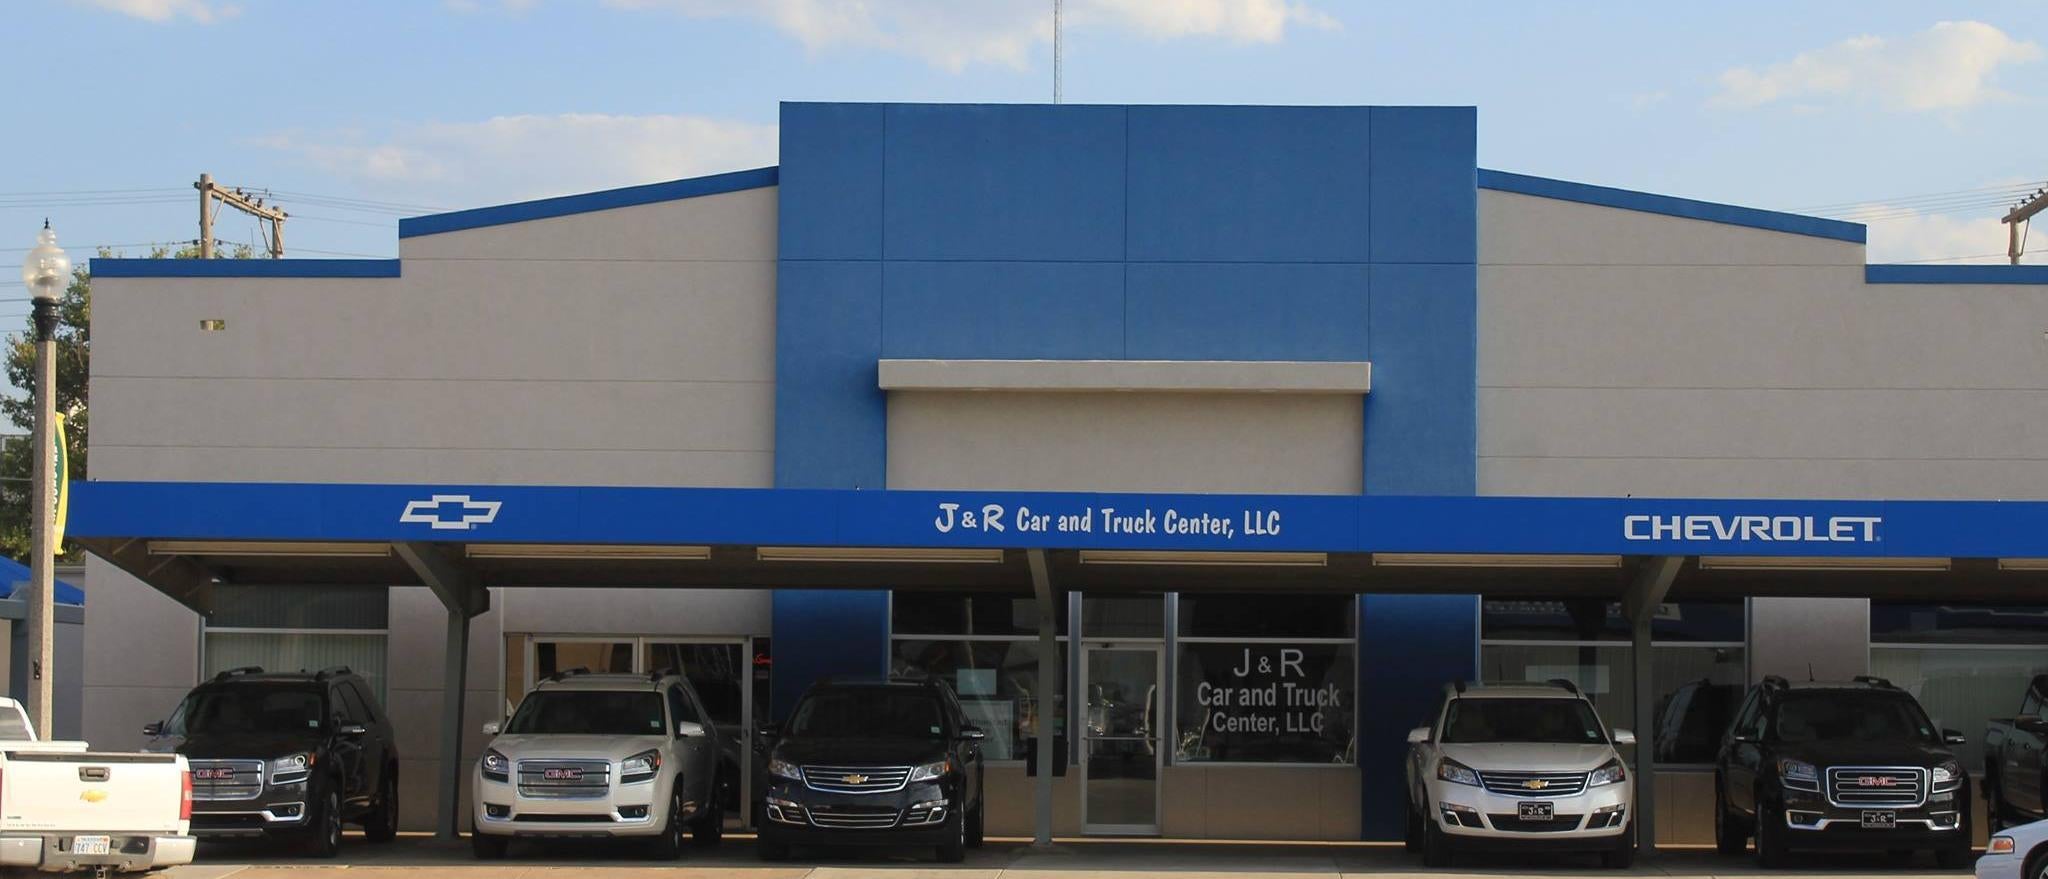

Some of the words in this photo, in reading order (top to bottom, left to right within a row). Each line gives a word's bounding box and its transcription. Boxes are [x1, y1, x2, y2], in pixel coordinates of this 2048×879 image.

[1016, 506, 1051, 532] Car
[1058, 507, 1092, 533] and
[1101, 507, 1156, 534] Truck
[1163, 508, 1234, 539] Center,
[1244, 510, 1281, 536] LLC
[1623, 515, 1882, 542] CHEVROLET
[1233, 648, 1250, 677] J
[1257, 656, 1272, 674] &
[1280, 648, 1305, 677] R
[1197, 681, 1234, 706] Car
[1238, 682, 1276, 707] and
[1283, 682, 1340, 708] Truck
[1212, 711, 1280, 735] Center,
[1286, 712, 1325, 734] LLC
[197, 769, 233, 779] GMC
[545, 769, 582, 779] GMC
[1859, 776, 1897, 786] GMC
